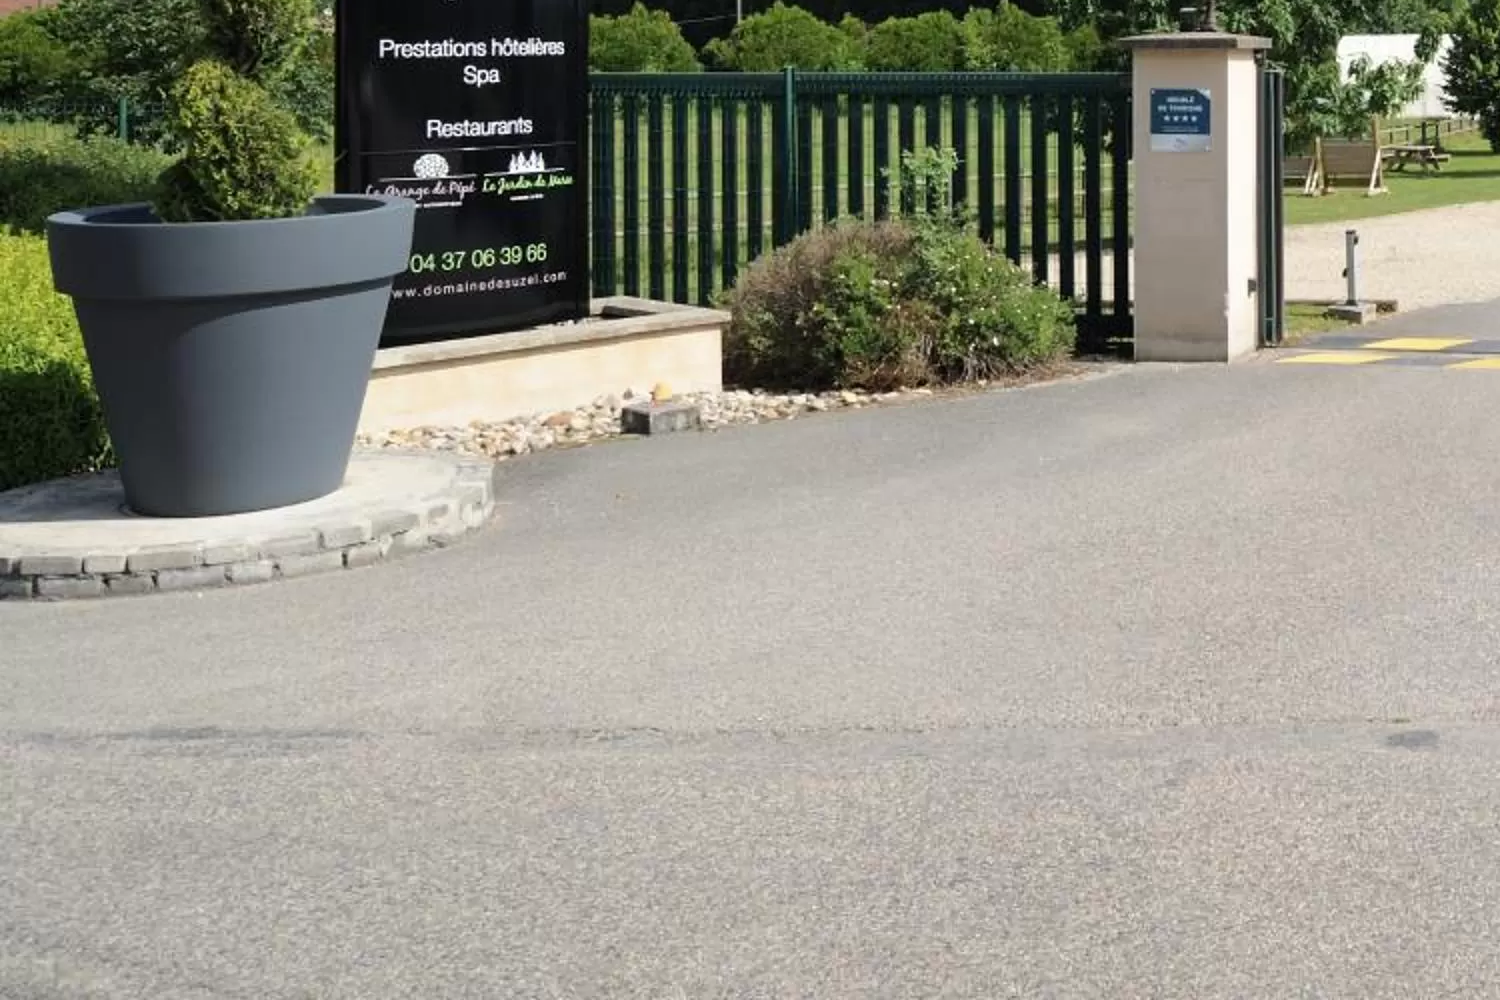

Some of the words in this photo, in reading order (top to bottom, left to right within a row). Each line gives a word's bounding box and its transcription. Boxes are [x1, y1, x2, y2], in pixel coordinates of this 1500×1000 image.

[378, 38, 487, 59] Prestations
[491, 37, 566, 57] hôtelières
[463, 65, 501, 87] Spa
[426, 116, 534, 139] Restaurants
[410, 254, 436, 273] 04
[441, 251, 467, 271] 37
[471, 248, 496, 268] 06
[500, 245, 523, 266] 39
[526, 243, 548, 263] 66
[391, 271, 567, 299] ww.domainedesuzel.com
